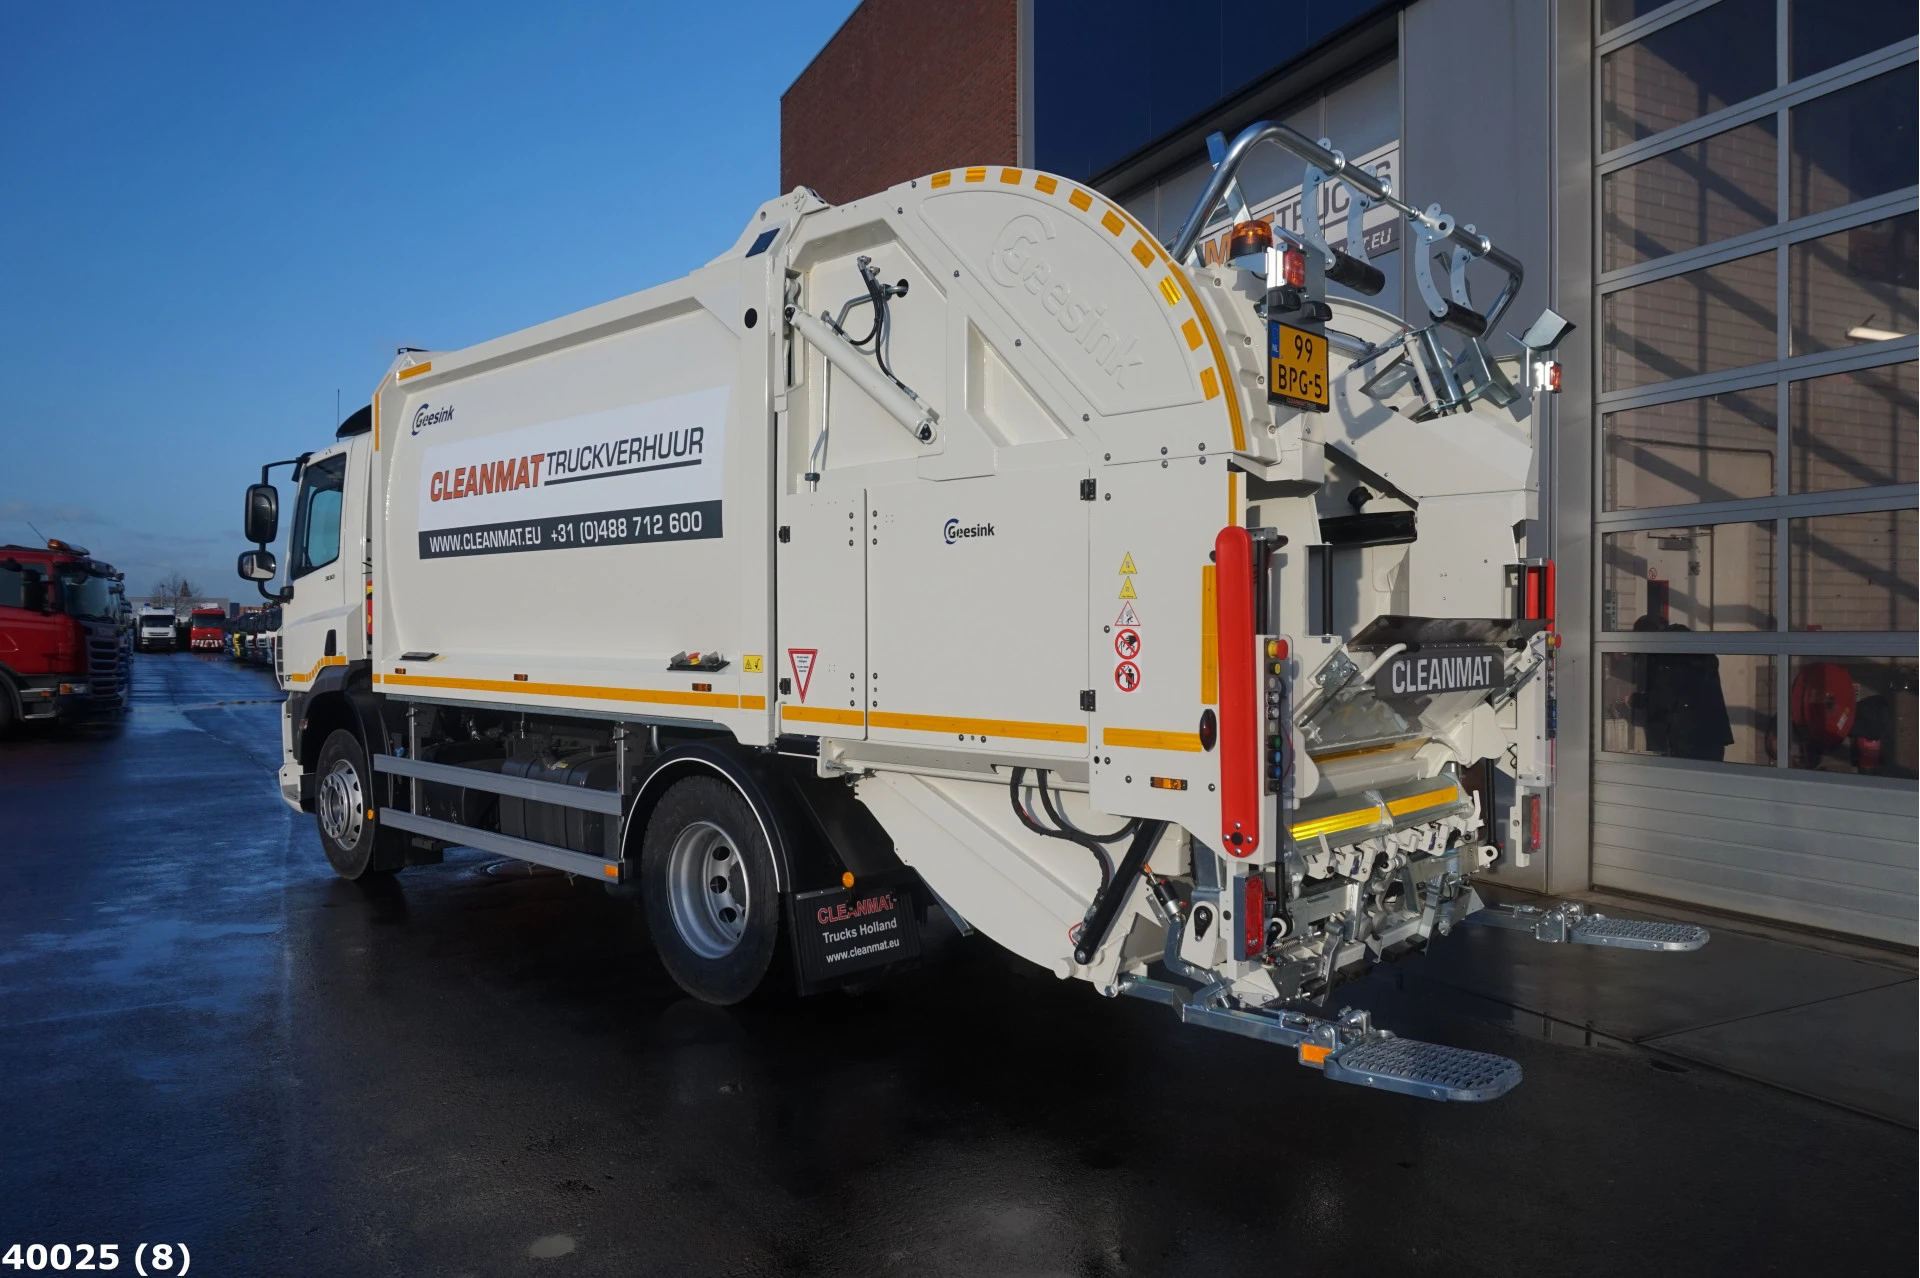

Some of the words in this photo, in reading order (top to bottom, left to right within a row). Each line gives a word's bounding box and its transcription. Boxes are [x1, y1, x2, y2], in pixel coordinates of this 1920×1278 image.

[986, 214, 1144, 390] Geesink
[1294, 334, 1313, 363] 99
[1278, 363, 1322, 399] BPG-5
[411, 403, 455, 436] Geesink
[430, 453, 545, 502] CLEANMAT
[546, 426, 705, 476] TRUCKVERHUUR
[429, 526, 542, 553] WWW.CLEANMAT.EU
[550, 522, 575, 544] +31
[579, 517, 628, 544] (0)488
[633, 514, 663, 537] 712
[669, 510, 703, 534] 600
[943, 518, 996, 545] Geesink
[1392, 655, 1493, 694] CLEANMAT
[822, 928, 858, 944] Trucks
[859, 917, 898, 936] Holland
[826, 938, 900, 963] www.cleanmat.eu
